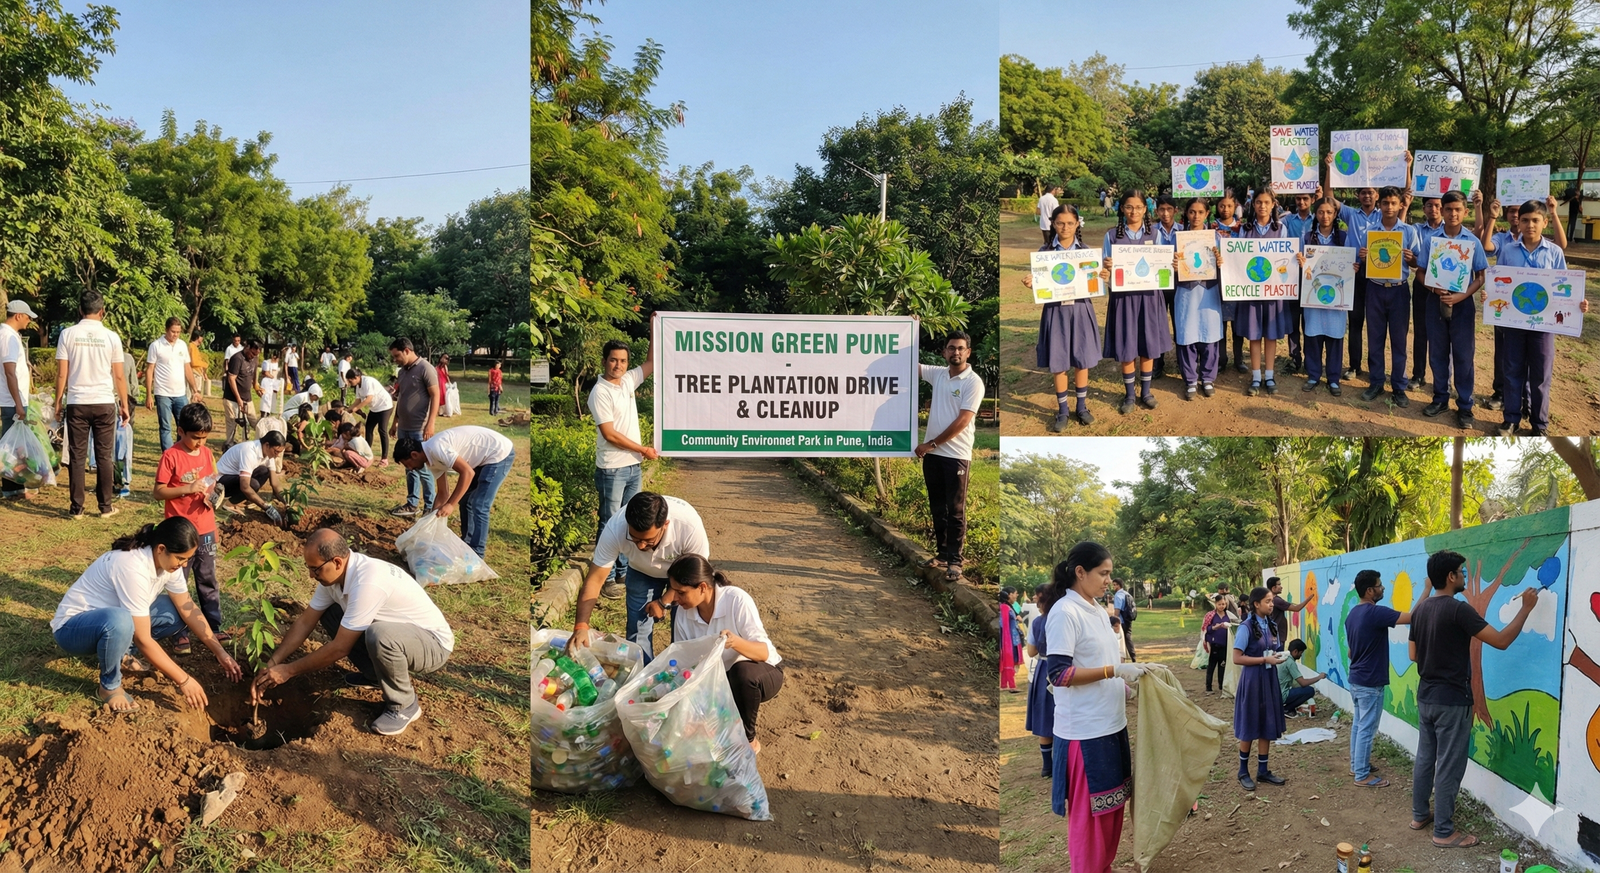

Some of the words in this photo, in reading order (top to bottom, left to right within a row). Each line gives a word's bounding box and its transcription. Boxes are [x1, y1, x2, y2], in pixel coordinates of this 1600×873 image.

[1272, 127, 1292, 137] SAVE
[1294, 127, 1318, 137] WATER
[1280, 137, 1311, 147] PLASTIC
[1173, 157, 1191, 167] SAVE
[1196, 157, 1217, 165] WATER
[1416, 154, 1438, 162] SAVE
[1272, 181, 1294, 190] SAVE
[1226, 241, 1254, 253] SAVE
[1225, 284, 1260, 297] RECYCLE
[1264, 284, 1298, 297] PLASTIC
[675, 330, 764, 353] MISSION
[771, 332, 838, 354] GREEN
[846, 333, 900, 355] PUNE
[675, 374, 722, 394] TREE
[728, 375, 839, 395] PLANTATION
[845, 376, 899, 395] DRIVE
[736, 400, 750, 419] &
[756, 400, 840, 419] CLEANUP
[681, 434, 738, 447] Community
[742, 434, 795, 446] Environnet
[798, 434, 822, 446] Park
[824, 435, 834, 446] in
[836, 435, 865, 448] Pune,
[867, 434, 893, 446] India
